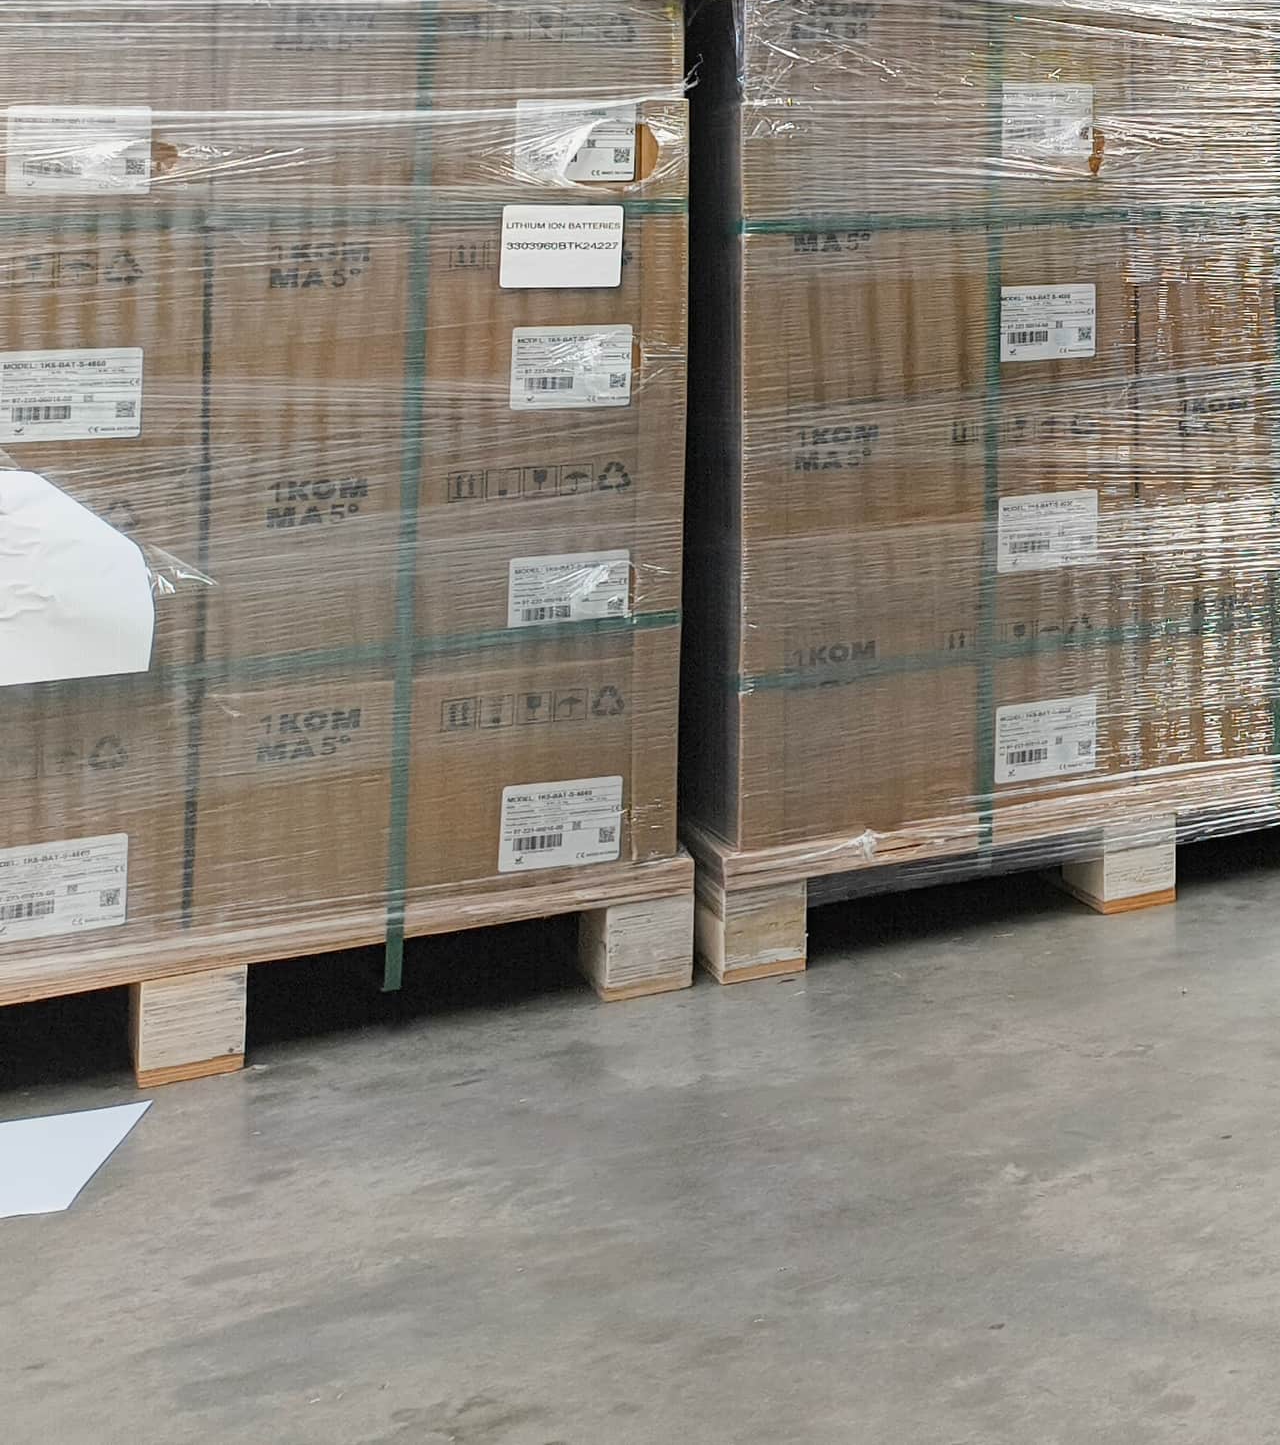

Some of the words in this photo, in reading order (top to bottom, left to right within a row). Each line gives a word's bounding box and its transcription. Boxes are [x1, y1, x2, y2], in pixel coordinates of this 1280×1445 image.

[506, 222, 546, 230] LITHIUM
[548, 222, 565, 230] ION
[569, 222, 621, 230] BATTERIES
[506, 241, 619, 251] 3303960BTK24227
[266, 476, 369, 502] 1KOM
[792, 639, 877, 667] 1KOM
[259, 708, 360, 735] 1KOM
